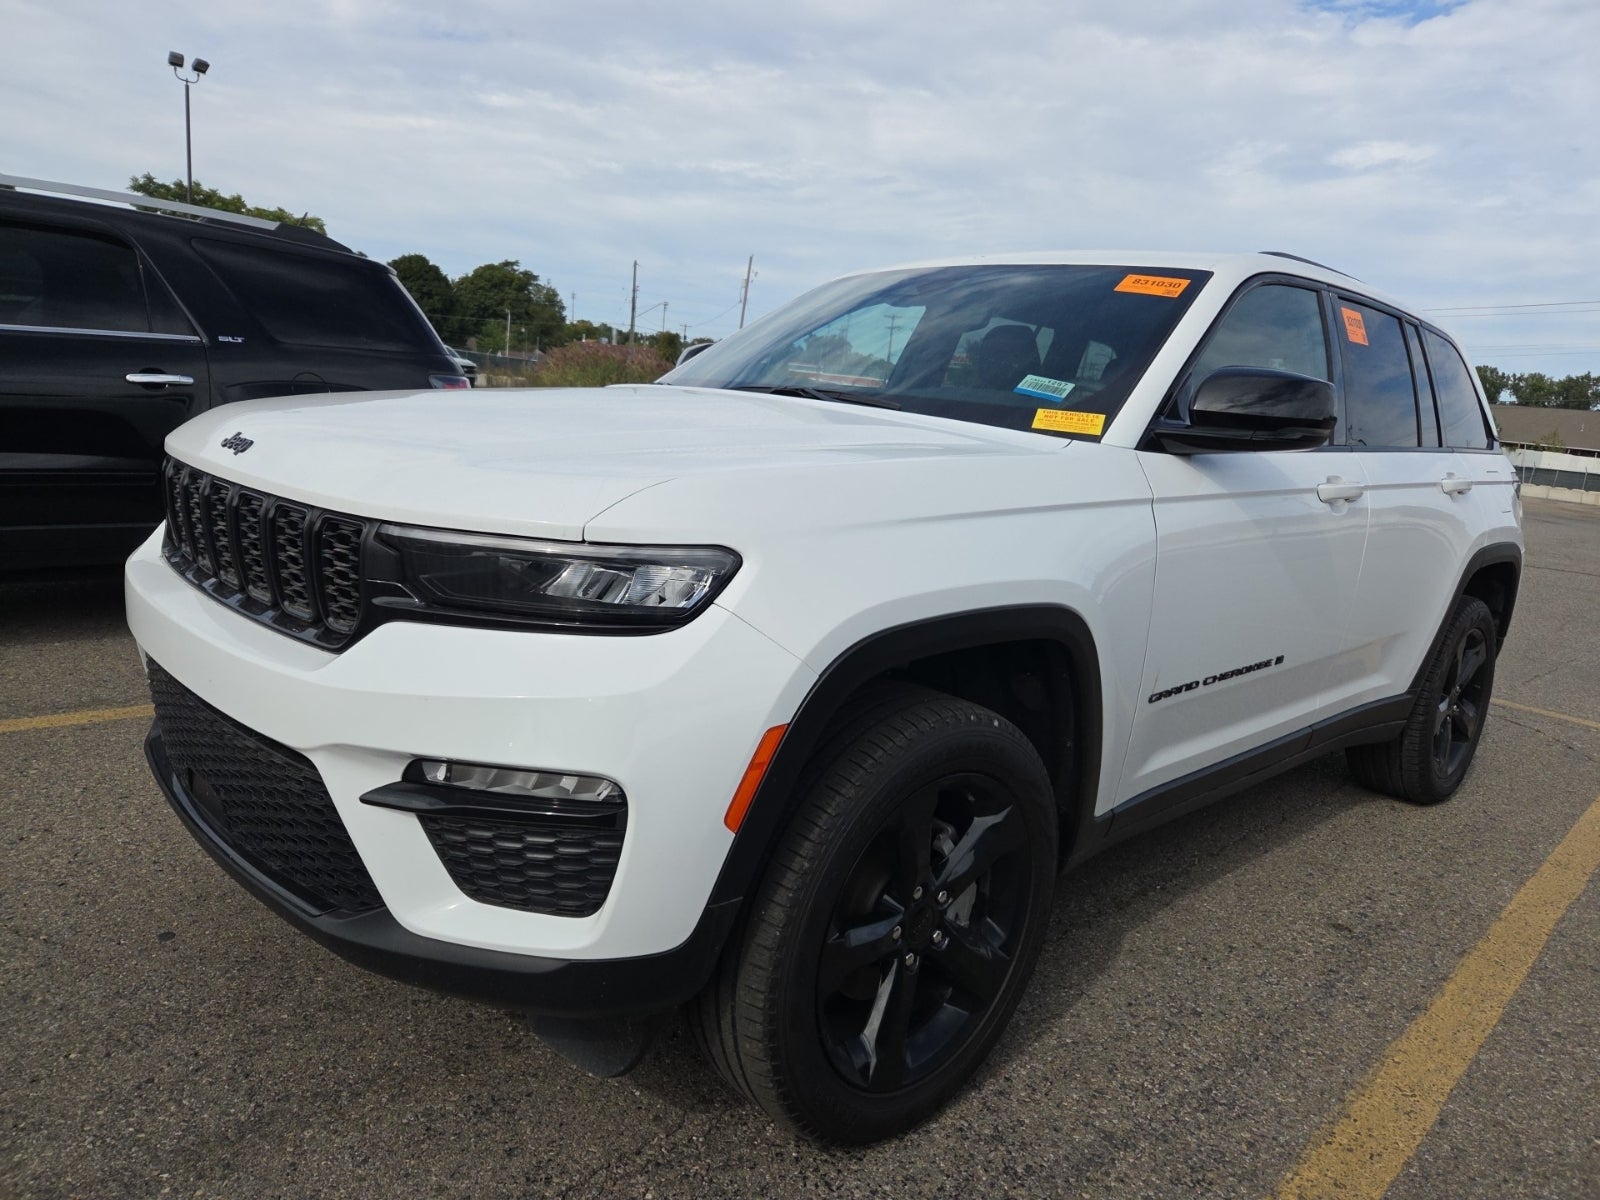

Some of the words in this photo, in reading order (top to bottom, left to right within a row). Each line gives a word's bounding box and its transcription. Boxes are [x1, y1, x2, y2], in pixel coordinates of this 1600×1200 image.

[1132, 278, 1182, 289] 831030
[218, 335, 246, 343] SLT
[220, 431, 255, 456] Jeep
[1147, 680, 1200, 704] GRAND
[1202, 658, 1275, 686] CHEROKEE
